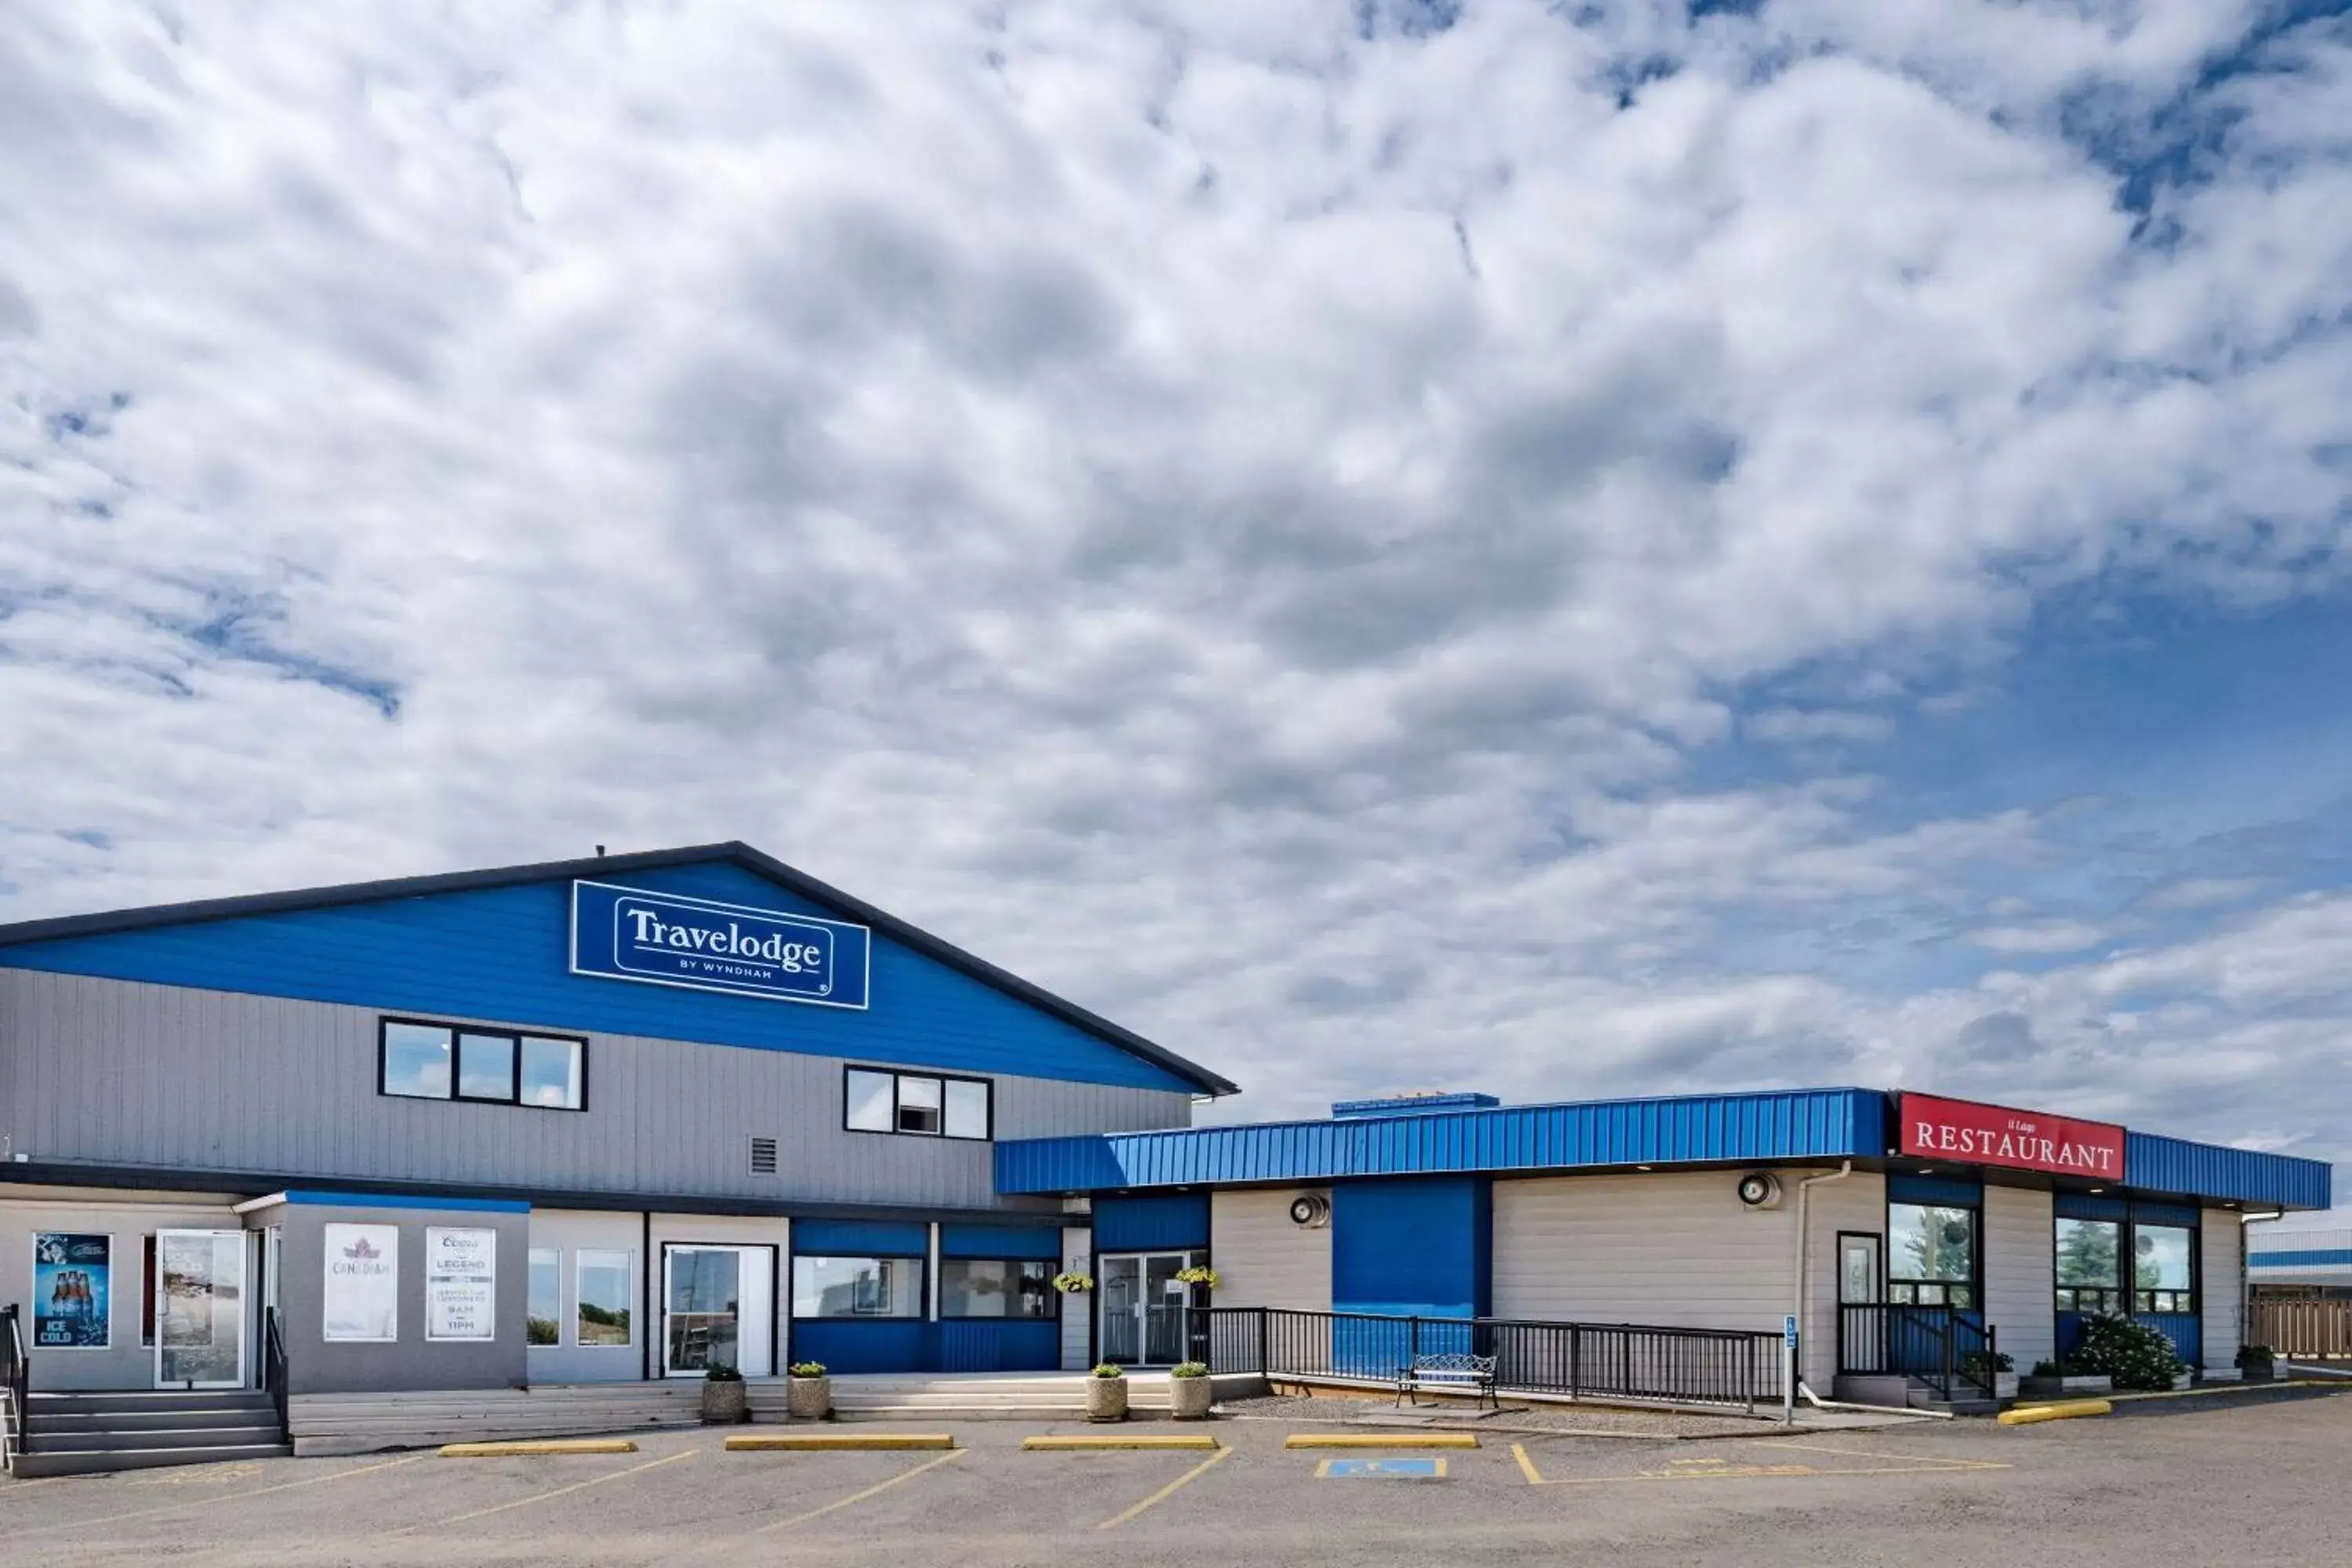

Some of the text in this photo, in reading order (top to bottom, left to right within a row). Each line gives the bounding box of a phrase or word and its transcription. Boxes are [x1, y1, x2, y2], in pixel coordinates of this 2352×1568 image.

[627, 909, 821, 973] Travelodge
[680, 959, 771, 978] BY WYNDHAM
[1915, 1122, 2114, 1170] RESTAURANT
[333, 1261, 390, 1275] CANDAN
[47, 1320, 67, 1331] ICE
[448, 1321, 474, 1330] 11PM
[40, 1332, 72, 1343] COLD
